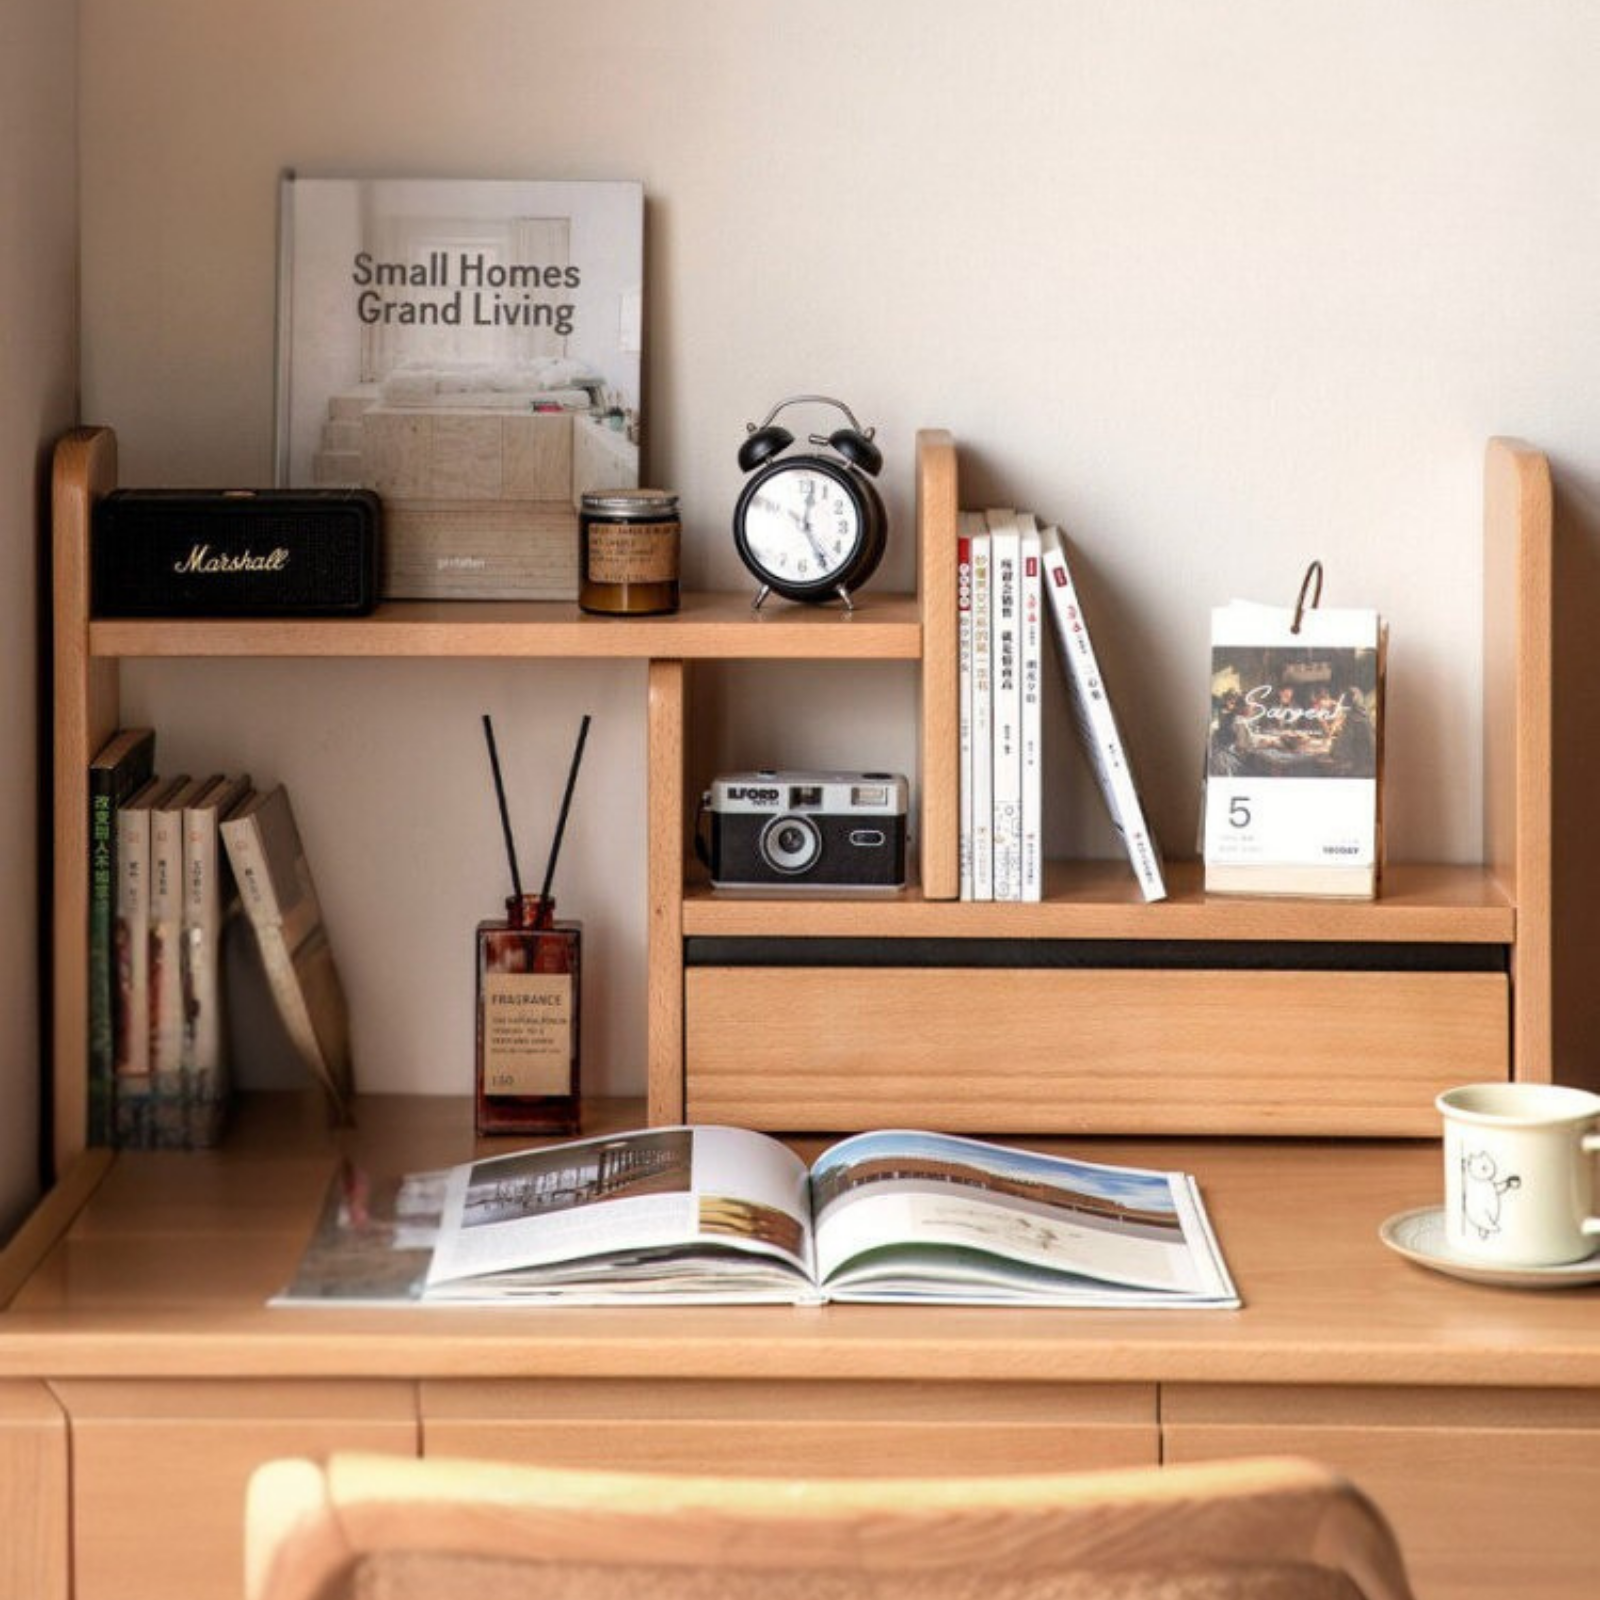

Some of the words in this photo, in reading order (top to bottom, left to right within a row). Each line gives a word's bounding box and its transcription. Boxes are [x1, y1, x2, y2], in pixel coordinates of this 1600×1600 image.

[352, 252, 448, 286] Small
[460, 253, 581, 288] Homes
[358, 290, 461, 325] Grand
[473, 292, 576, 336] Living
[174, 544, 290, 573] Marshall
[727, 786, 780, 801] ILFORD
[1228, 796, 1252, 829] 5
[491, 993, 562, 1006] FRAGRANCE
